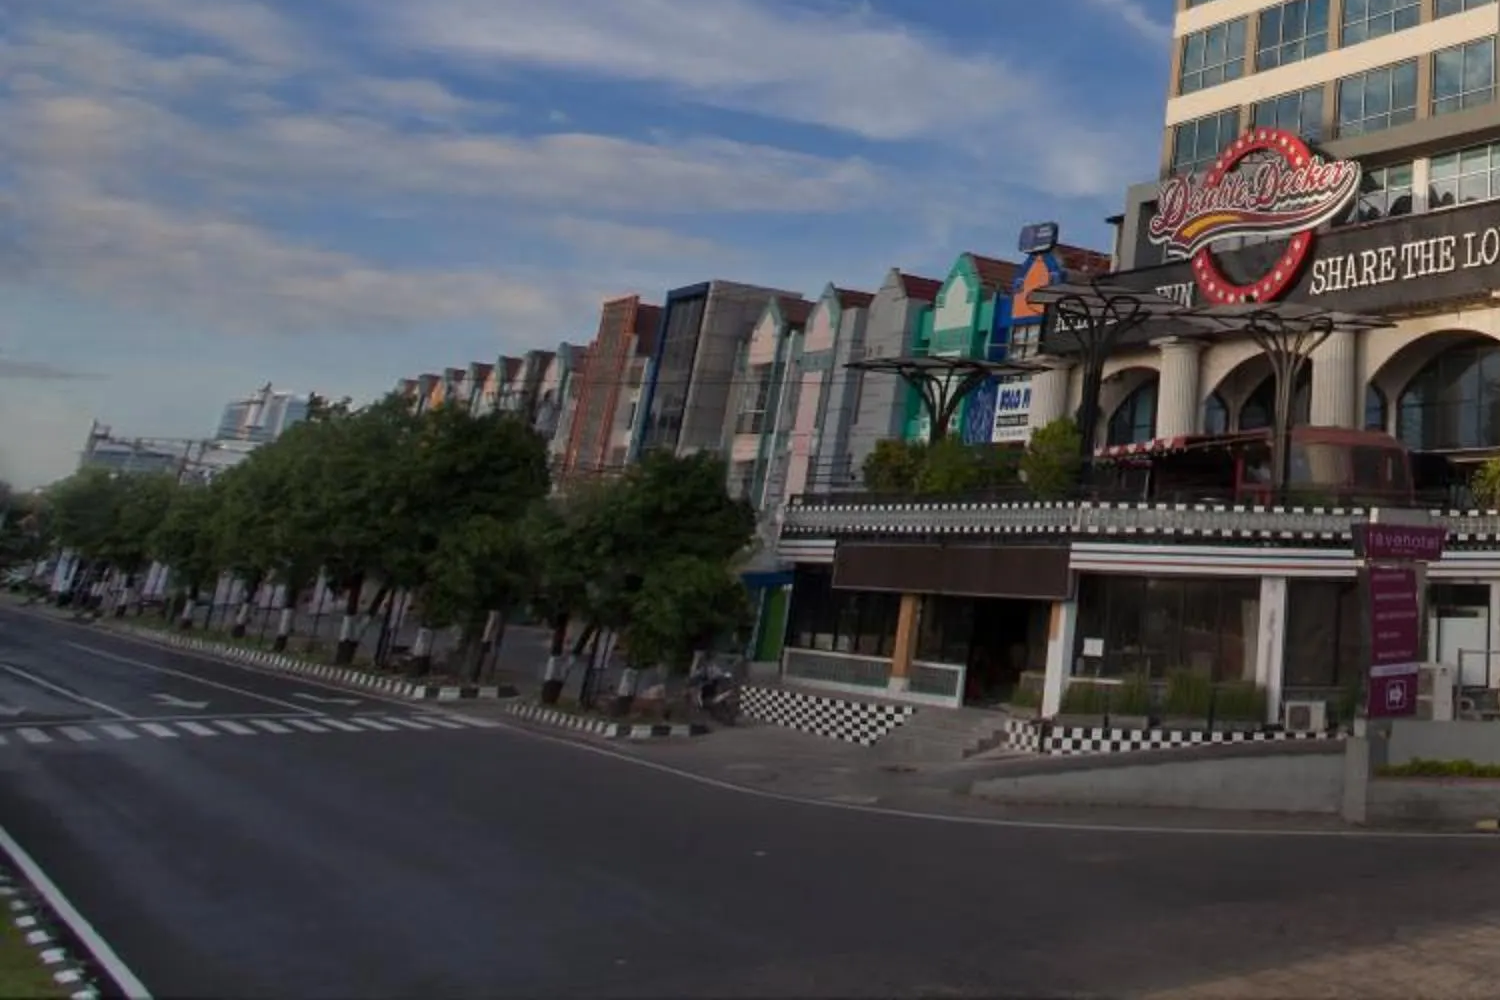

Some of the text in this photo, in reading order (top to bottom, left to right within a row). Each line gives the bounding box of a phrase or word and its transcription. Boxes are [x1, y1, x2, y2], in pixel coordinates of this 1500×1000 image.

[1151, 155, 1355, 234] Double Decker
[1309, 246, 1396, 295] SHARE
[1401, 235, 1456, 280] THE
